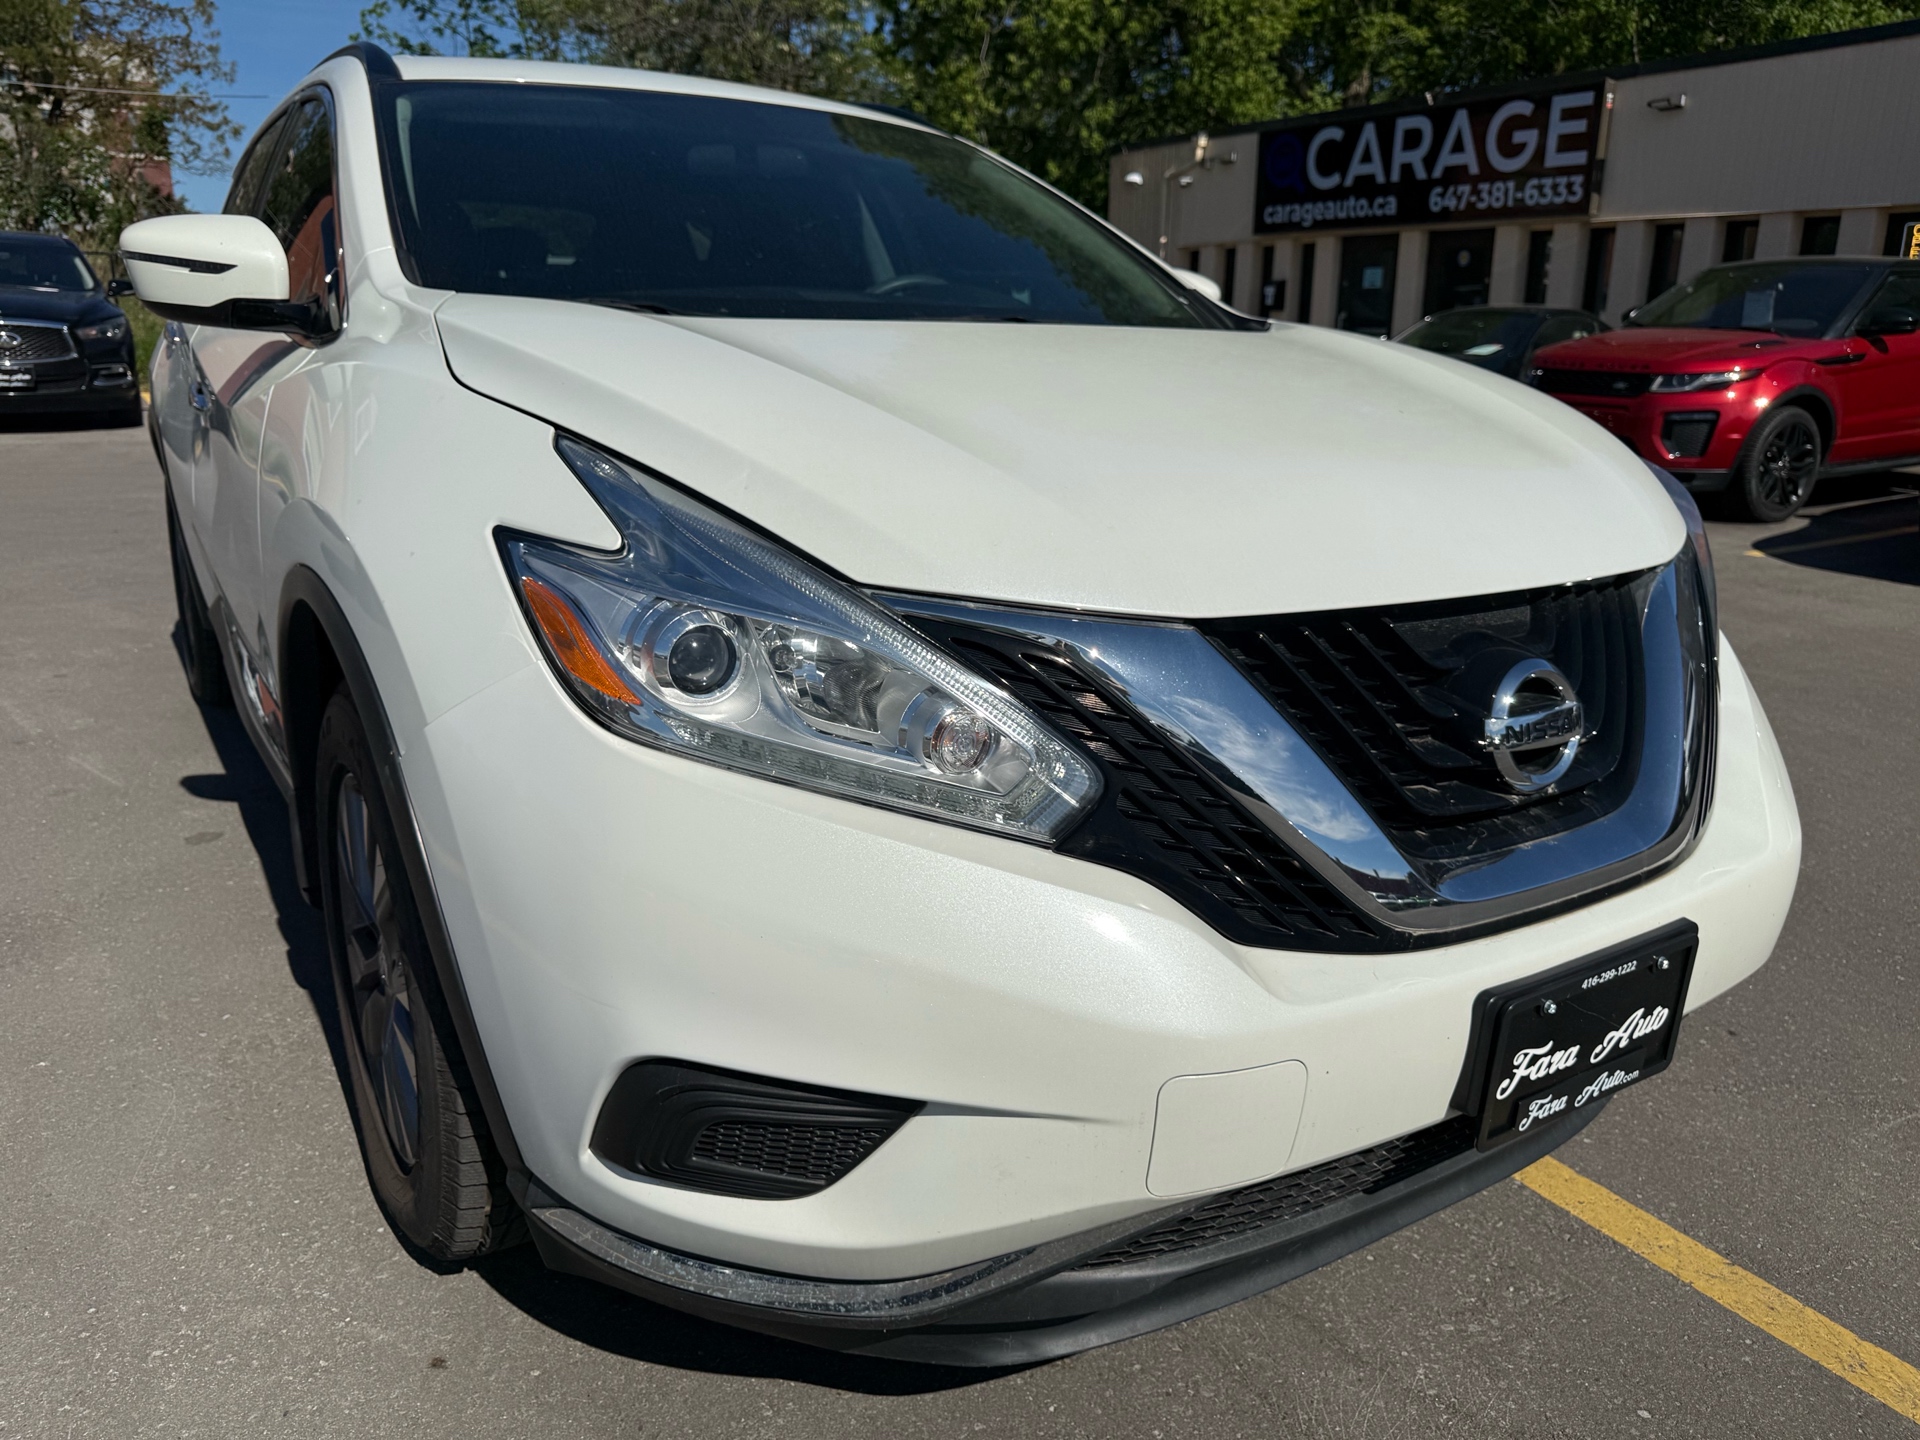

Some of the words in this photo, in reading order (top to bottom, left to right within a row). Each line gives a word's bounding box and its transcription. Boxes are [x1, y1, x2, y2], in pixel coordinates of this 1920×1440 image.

[1306, 91, 1595, 190] CARAGE
[1263, 195, 1398, 228] carageauto.ca
[1428, 174, 1585, 213] 647-381-6333
[1581, 960, 1638, 989] 416-299-1222
[1496, 1040, 1580, 1100] Fara
[1590, 1005, 1669, 1064] Auto
[1519, 1094, 1567, 1131] Fara
[1574, 1068, 1639, 1107] Auto.com
